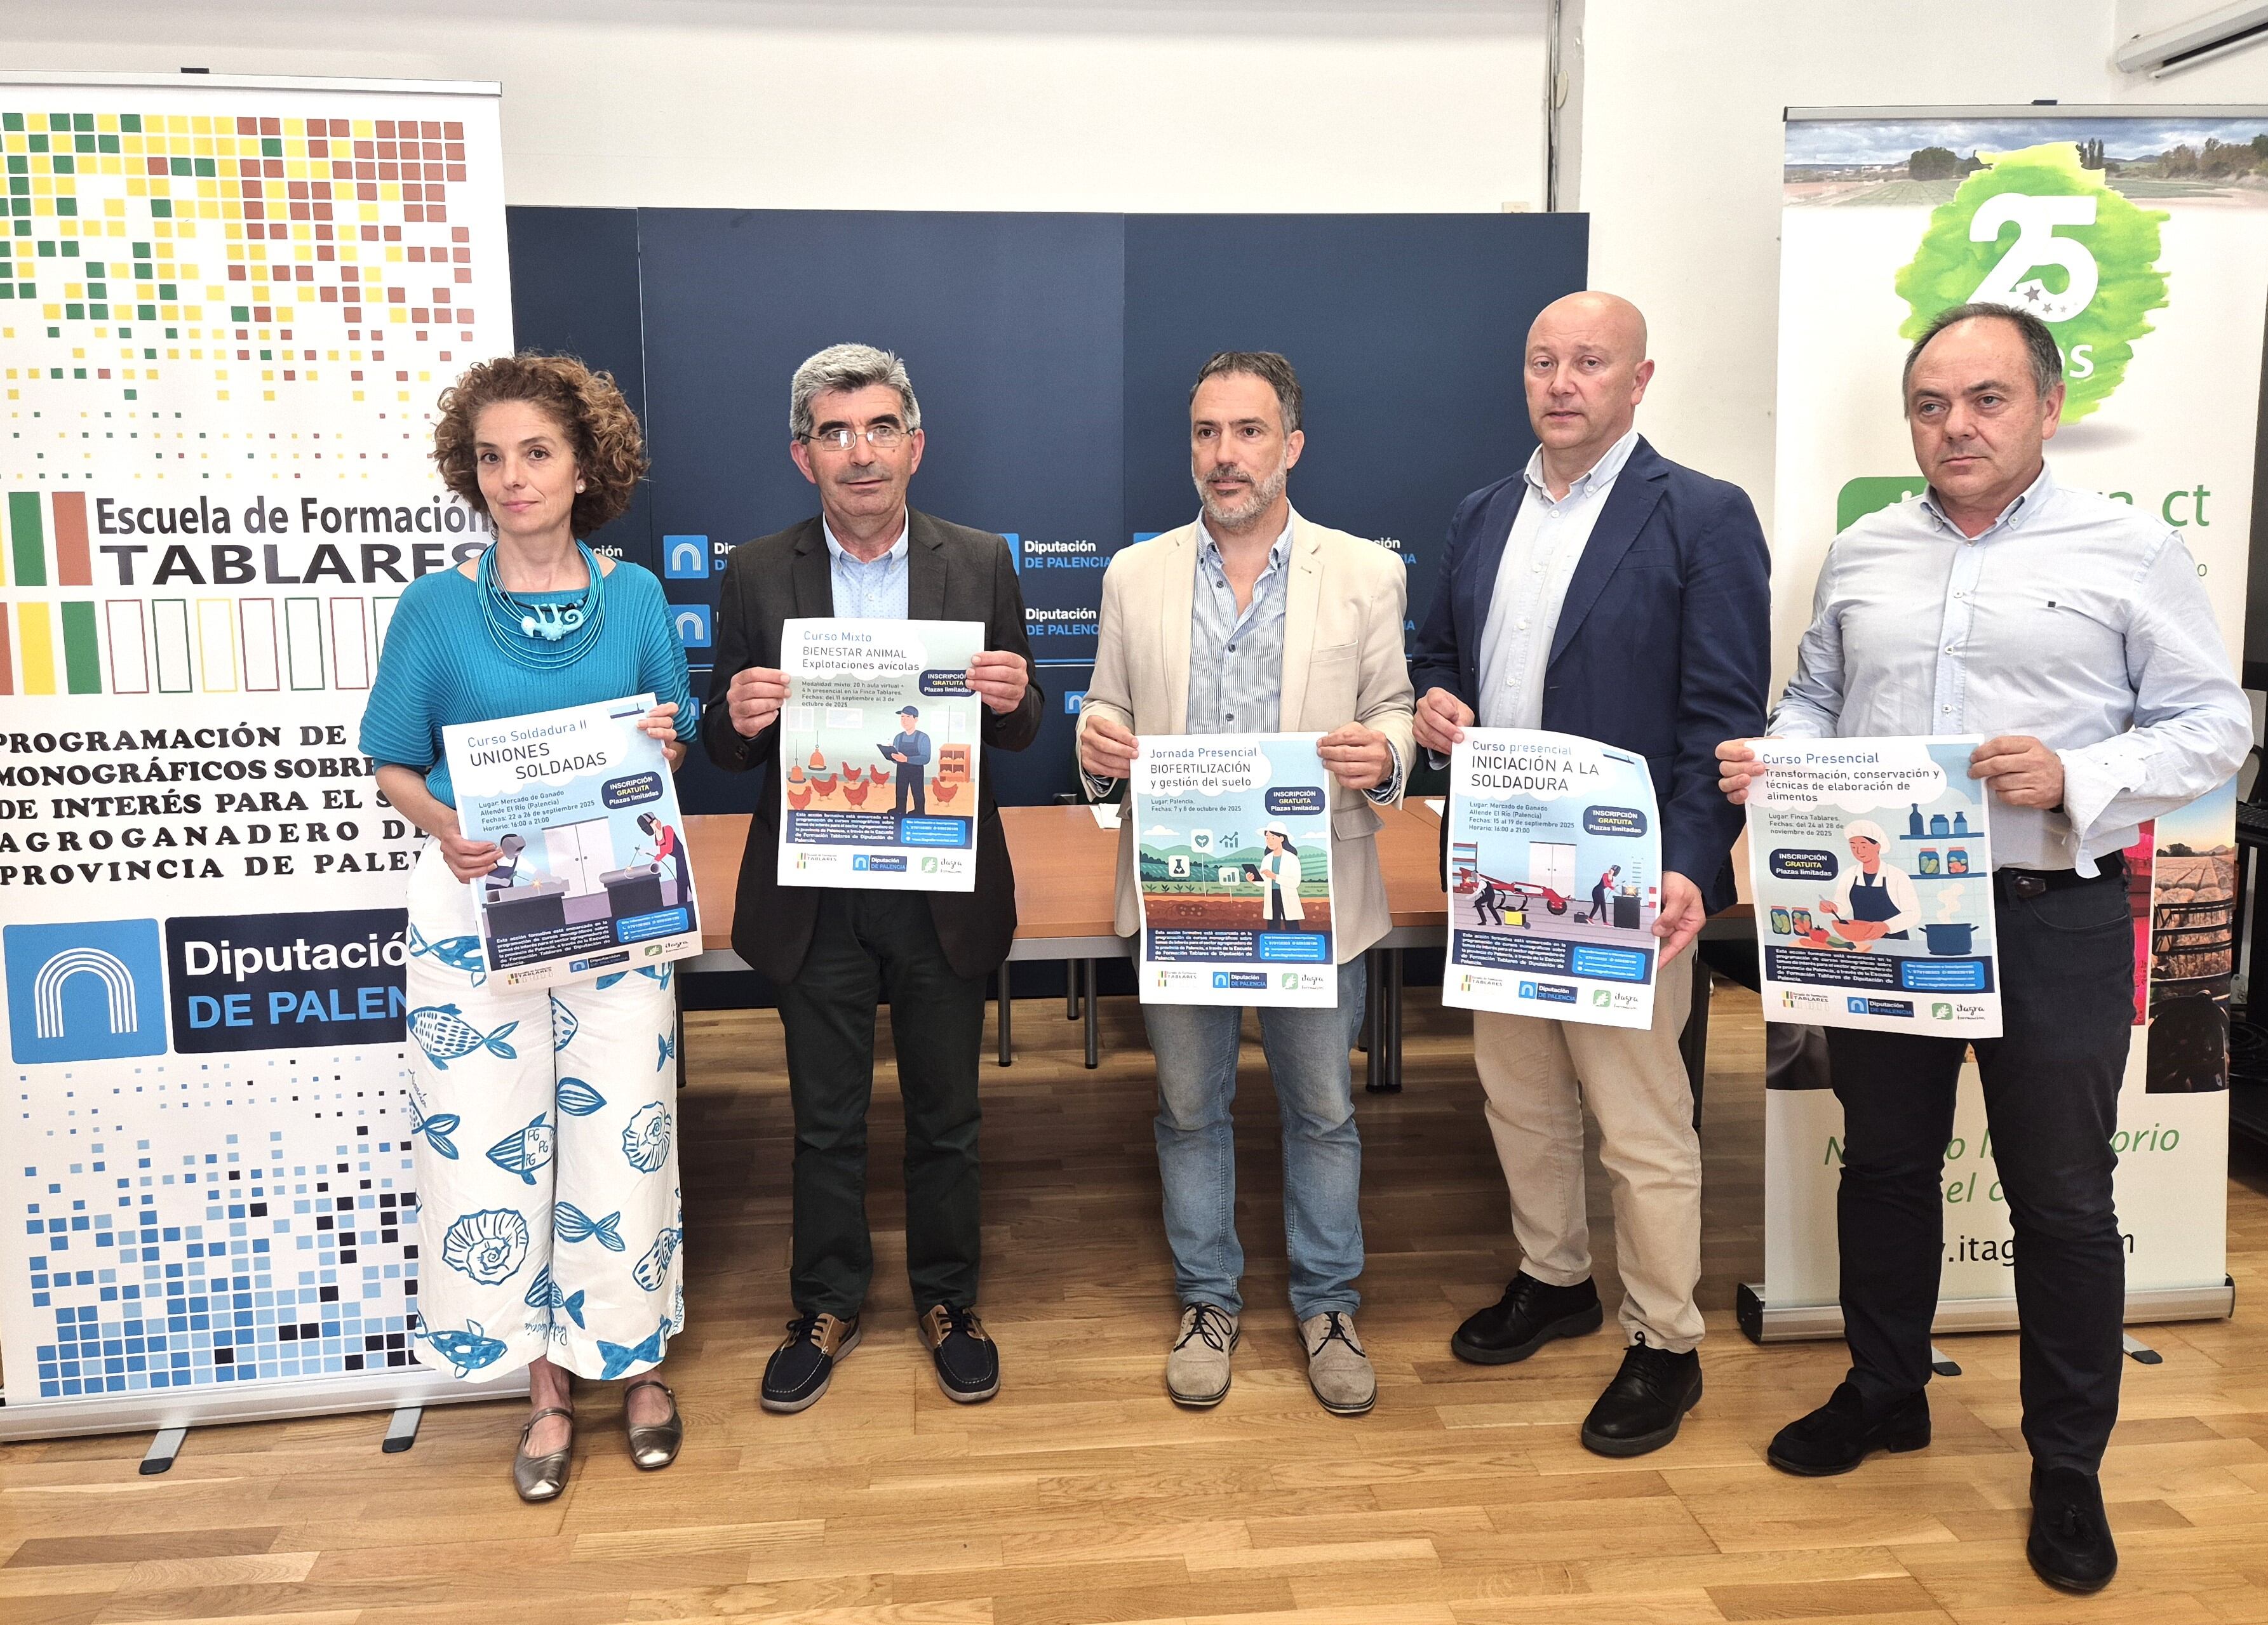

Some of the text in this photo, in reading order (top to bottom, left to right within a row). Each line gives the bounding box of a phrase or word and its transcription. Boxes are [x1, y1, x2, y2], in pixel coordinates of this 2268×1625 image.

[1966, 192, 2098, 323] 25
[96, 495, 490, 535] Escuela de Formación
[1024, 540, 1096, 554] Diputación
[1025, 557, 1043, 568] DE
[1025, 608, 1096, 622] Diputación
[803, 631, 871, 642] Curso Mixto
[1026, 624, 1099, 636] DE PALENC
[803, 646, 906, 658] BIENESTAR ANIMAL
[802, 659, 919, 671] Explotaciones avícolas
[299, 725, 346, 746] DE
[467, 719, 586, 747] Curso Soldadura II
[470, 742, 549, 766] UNIONES
[1150, 747, 1256, 758] Jornada Presencial
[1472, 740, 1571, 754] Curso presencial
[515, 752, 607, 779] SOLDADAS
[1472, 755, 1599, 775] INICIACIÓN A LA
[1762, 752, 1879, 765] Curso Presencial
[1151, 761, 1250, 773] BIOFERTILIZACIÓN
[1765, 768, 1939, 780] Transformación, conservación y
[610, 775, 652, 790] INSCRIPCIÓN
[1150, 776, 1251, 789] y gestión del suelo
[1471, 773, 1568, 791] SOLDADURA
[1766, 780, 1910, 791] técnicas de elaboración de
[616, 784, 649, 796] GRATUITA
[1767, 791, 1818, 801] alimentos
[0, 799, 37, 820] DE
[51, 788, 201, 819] INTERÉS
[215, 791, 309, 813] PARA
[322, 789, 362, 809] EL
[500, 796, 528, 805] Mercado
[540, 790, 564, 799] Ganado
[608, 791, 659, 805] Plazas limitadas
[480, 808, 504, 816] Allende
[527, 798, 559, 810] (Palencia)
[542, 805, 578, 815] septiembre
[579, 799, 594, 808] 2025
[1592, 810, 1637, 819] INSCRIPCIÓN
[0, 821, 358, 853] AGROGANADERO
[0, 852, 410, 885] PROVINCIA DE PALE
[184, 931, 406, 982] Diputació
[188, 993, 253, 1028] DE
